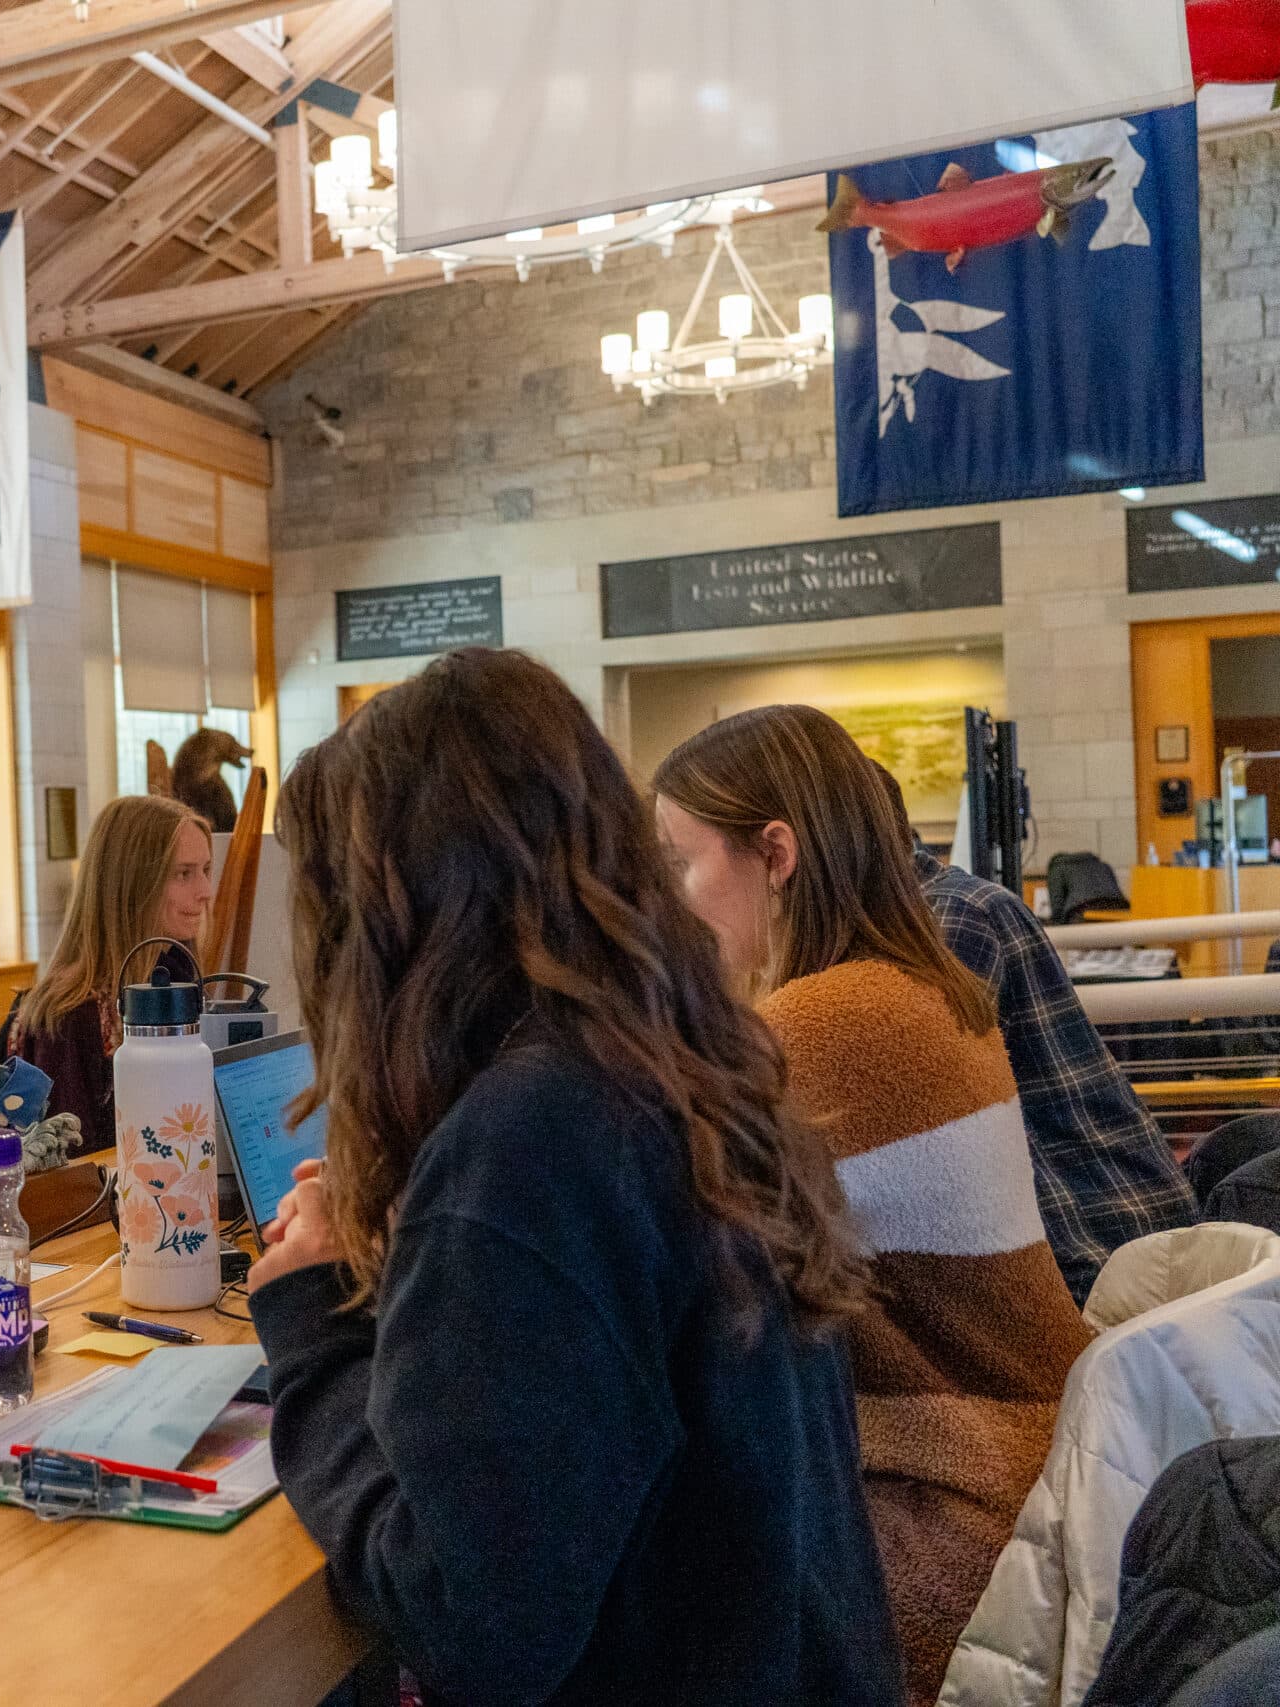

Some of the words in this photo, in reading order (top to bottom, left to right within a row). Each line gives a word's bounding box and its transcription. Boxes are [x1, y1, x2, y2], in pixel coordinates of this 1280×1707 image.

[710, 555, 791, 578] United
[802, 547, 880, 567] States
[746, 577, 790, 598] and
[800, 567, 902, 592] Wildlife
[748, 596, 835, 617] Service
